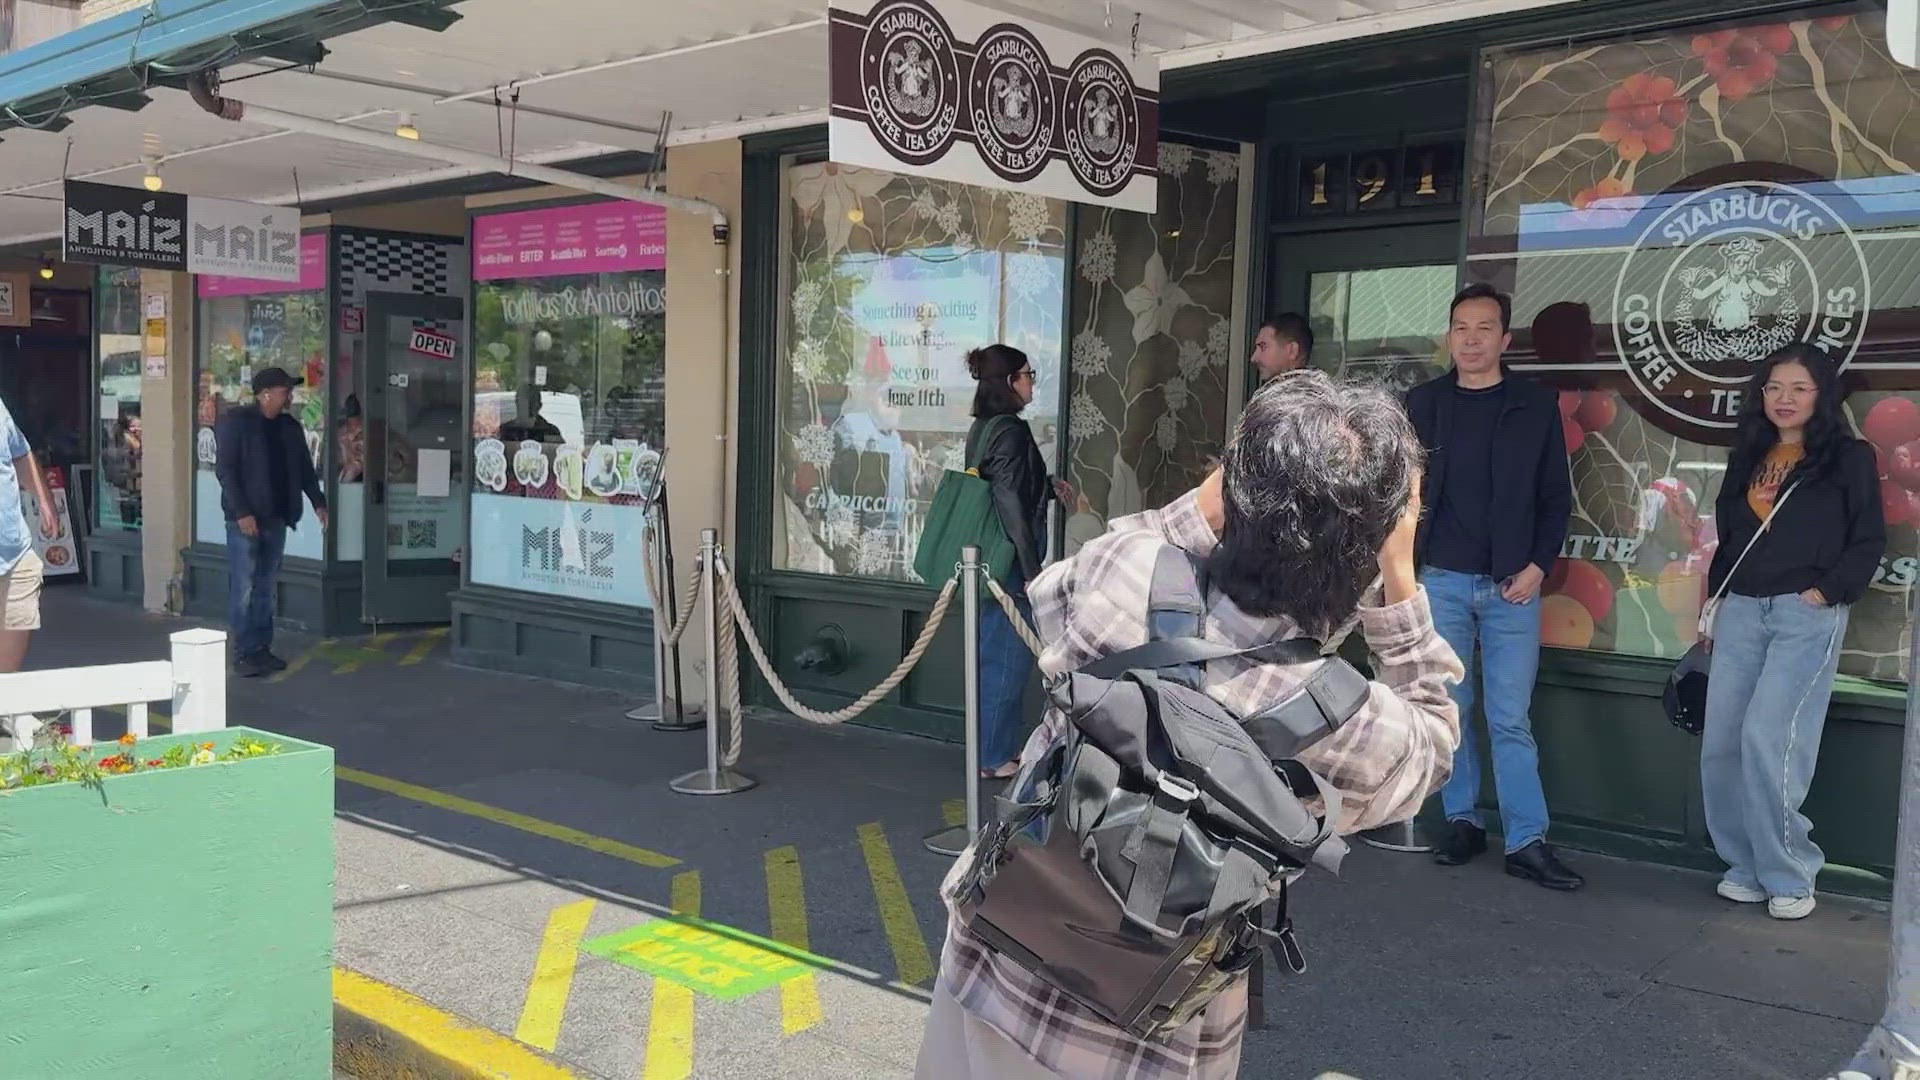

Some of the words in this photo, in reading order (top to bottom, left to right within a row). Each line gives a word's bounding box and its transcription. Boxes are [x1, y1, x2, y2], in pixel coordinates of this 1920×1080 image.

[880, 12, 944, 50] STARBUCKS
[986, 40, 1042, 76] STARBUCKS
[1078, 64, 1127, 97] STARBUCKS
[868, 85, 902, 142] COFFEE
[904, 132, 926, 150] TEA
[926, 103, 955, 146] SPICES
[975, 109, 1004, 161] COFFEE
[1006, 151, 1026, 168] TEA
[1025, 124, 1050, 164] SPICES
[1068, 129, 1093, 178] COFFEE
[1095, 169, 1112, 184] TEA
[1112, 143, 1134, 181] SPICES
[68, 200, 181, 254] MAÍZ
[1662, 193, 1824, 247] STARBUCKS
[68, 245, 118, 258] ANTOJITOS
[194, 215, 296, 265] MAÍZ
[563, 285, 580, 316] &
[863, 302, 925, 321] Something
[415, 334, 452, 355] OPEN
[878, 331, 888, 347] is
[1623, 293, 1678, 391] COFFEE
[1710, 388, 1742, 417] TE
[1814, 286, 1857, 354] ICES
[891, 365, 912, 380] See
[914, 367, 940, 384] you
[887, 388, 914, 408] June
[917, 387, 945, 406] 11th
